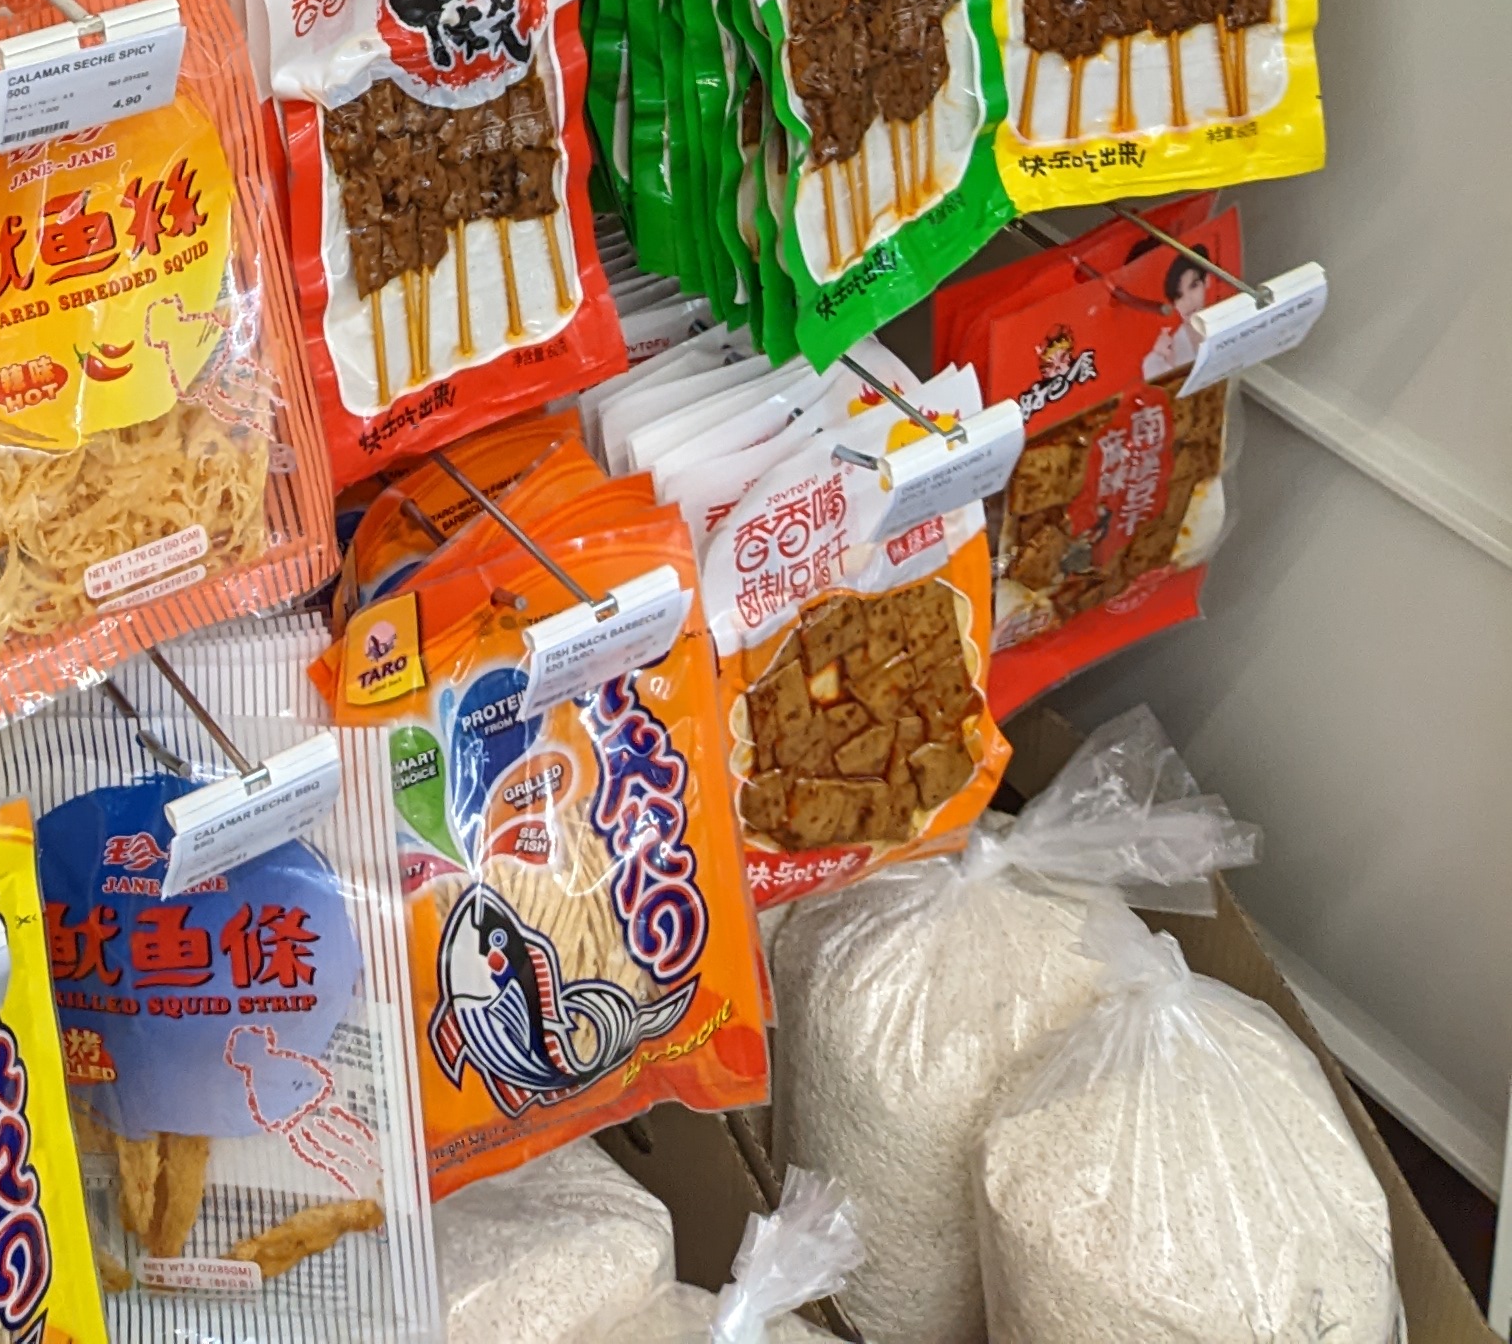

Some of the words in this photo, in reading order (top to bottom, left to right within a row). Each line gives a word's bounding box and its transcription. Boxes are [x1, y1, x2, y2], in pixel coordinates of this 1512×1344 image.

[7, 63, 71, 88] CALAMAR
[73, 52, 116, 72] SECHE
[118, 43, 156, 62] SPICY
[6, 86, 31, 100] 50G
[57, 266, 159, 318] SHREDDED
[162, 239, 210, 283] SQUID
[4, 383, 60, 414] HOT
[545, 645, 574, 664] FISH
[574, 628, 610, 653] SNACK
[610, 609, 668, 642] BARBECUE
[358, 655, 409, 690] TARO
[503, 764, 563, 803] GRILLED
[193, 810, 252, 842] CALAMAR
[253, 792, 294, 816] SECHE
[295, 780, 322, 799] BBQ
[515, 839, 549, 854] FISH
[518, 826, 548, 842] SEA
[148, 995, 232, 1019] SQUID
[238, 994, 318, 1013] STRIP
